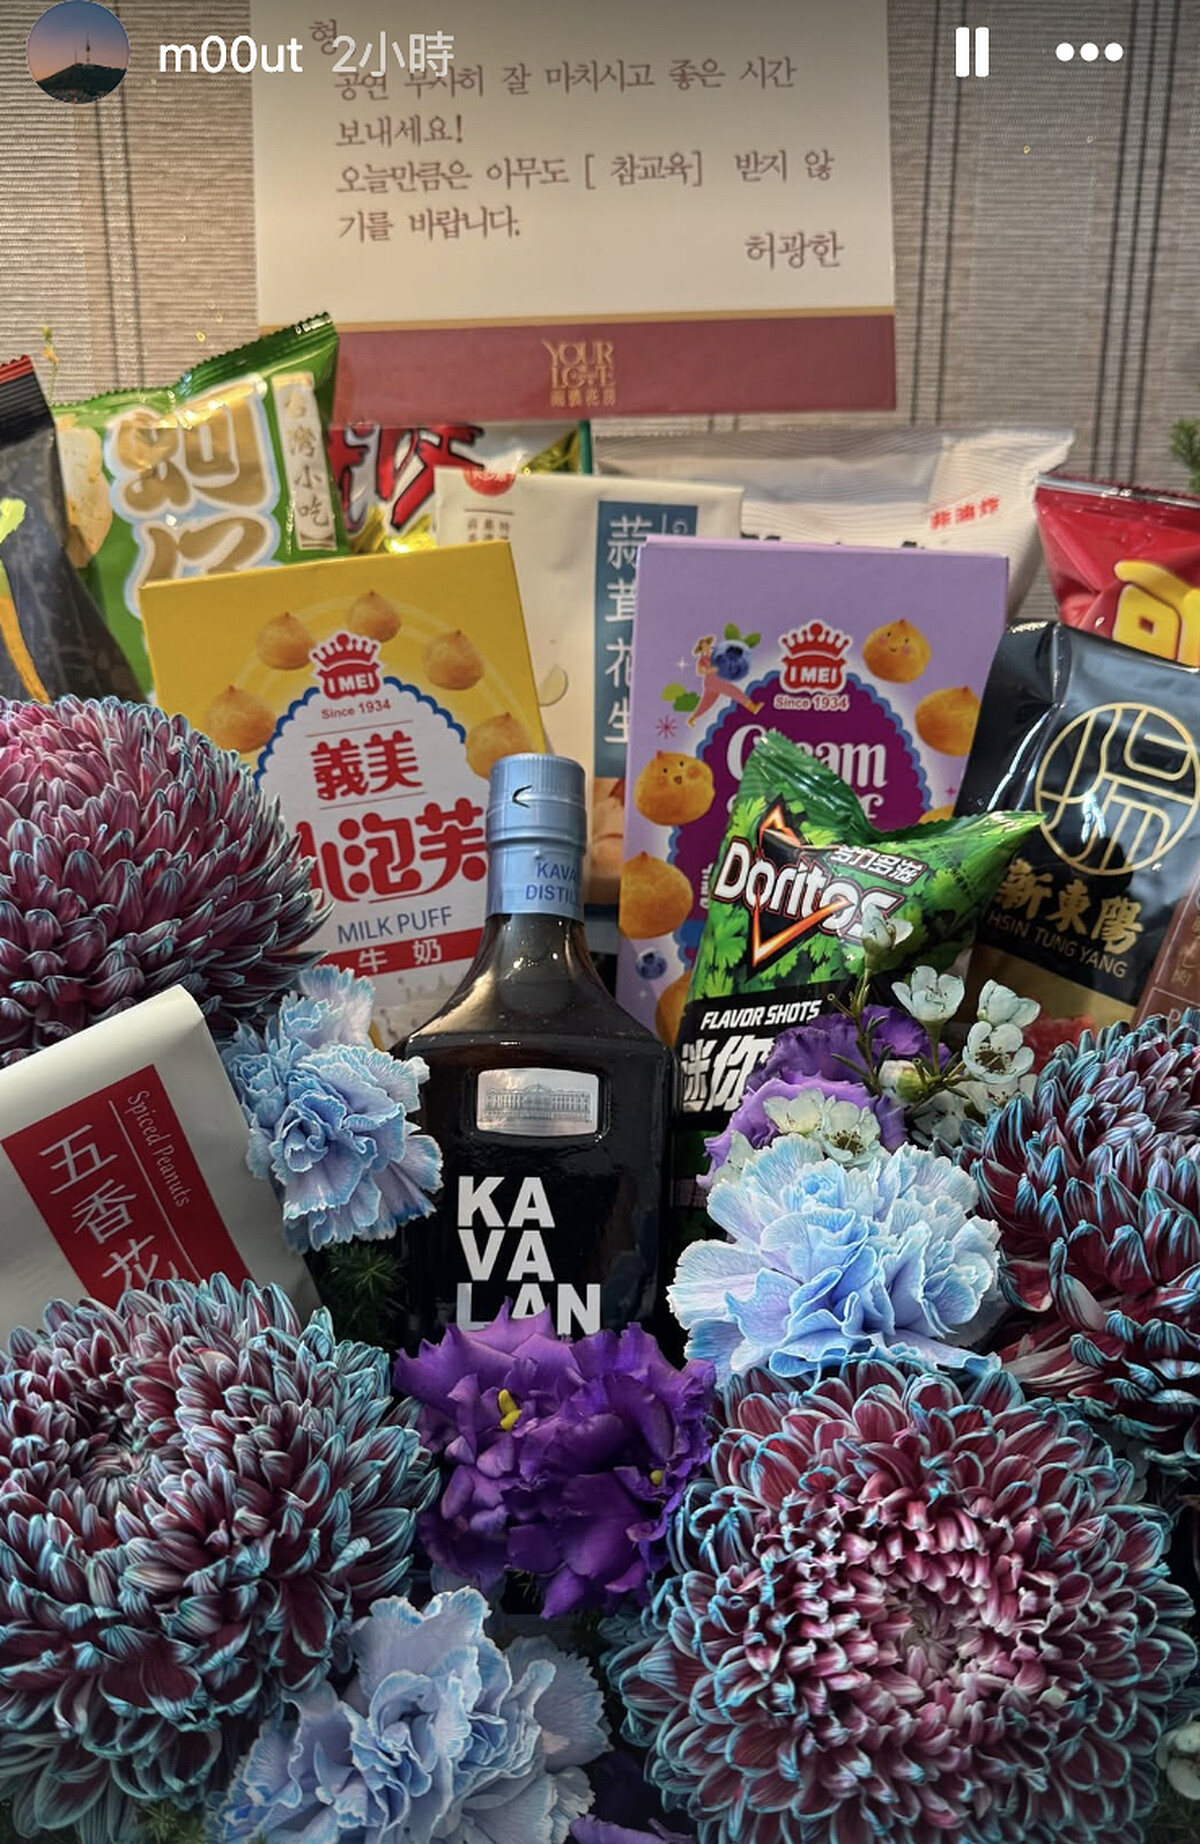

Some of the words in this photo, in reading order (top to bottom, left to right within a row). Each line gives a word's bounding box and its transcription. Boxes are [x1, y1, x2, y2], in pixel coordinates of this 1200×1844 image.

[334, 68, 389, 101] 공연
[403, 64, 484, 99] 무사히
[502, 62, 532, 95] 잘
[545, 59, 655, 95] 마치시고
[669, 58, 726, 91] 좋은
[740, 56, 797, 89] 시간
[335, 114, 463, 148] 보내세요!
[336, 160, 472, 194] 오늘만큼은
[486, 157, 570, 190] 아무도
[734, 149, 788, 183] 받지
[804, 149, 835, 182] 않
[339, 211, 393, 243] 기를
[409, 205, 520, 241] 바랍니다.
[745, 230, 845, 271] 허광한
[340, 672, 375, 692] MEI
[801, 667, 837, 684] MEI
[321, 706, 355, 720] Since
[358, 700, 391, 715] 1934
[775, 696, 811, 709] Since
[814, 696, 849, 711] 1934
[311, 730, 423, 800] 義美
[727, 724, 888, 788] Cam
[716, 842, 900, 938] Doritos
[996, 858, 1144, 955] 新東陽
[338, 919, 392, 945] MILK
[398, 906, 453, 931] PUFF
[987, 910, 1030, 939] HSIN
[1034, 926, 1078, 957] TUNG
[1079, 946, 1128, 978] YANG
[358, 939, 443, 974] 牛奶
[700, 1006, 766, 1030] FLAVOR
[764, 1000, 822, 1025] SHOTS
[128, 1090, 161, 1146] Spiced
[153, 1134, 190, 1208] Peanuts
[457, 1176, 556, 1228] KA
[457, 1229, 556, 1282] VA
[456, 1282, 601, 1336] LAN
